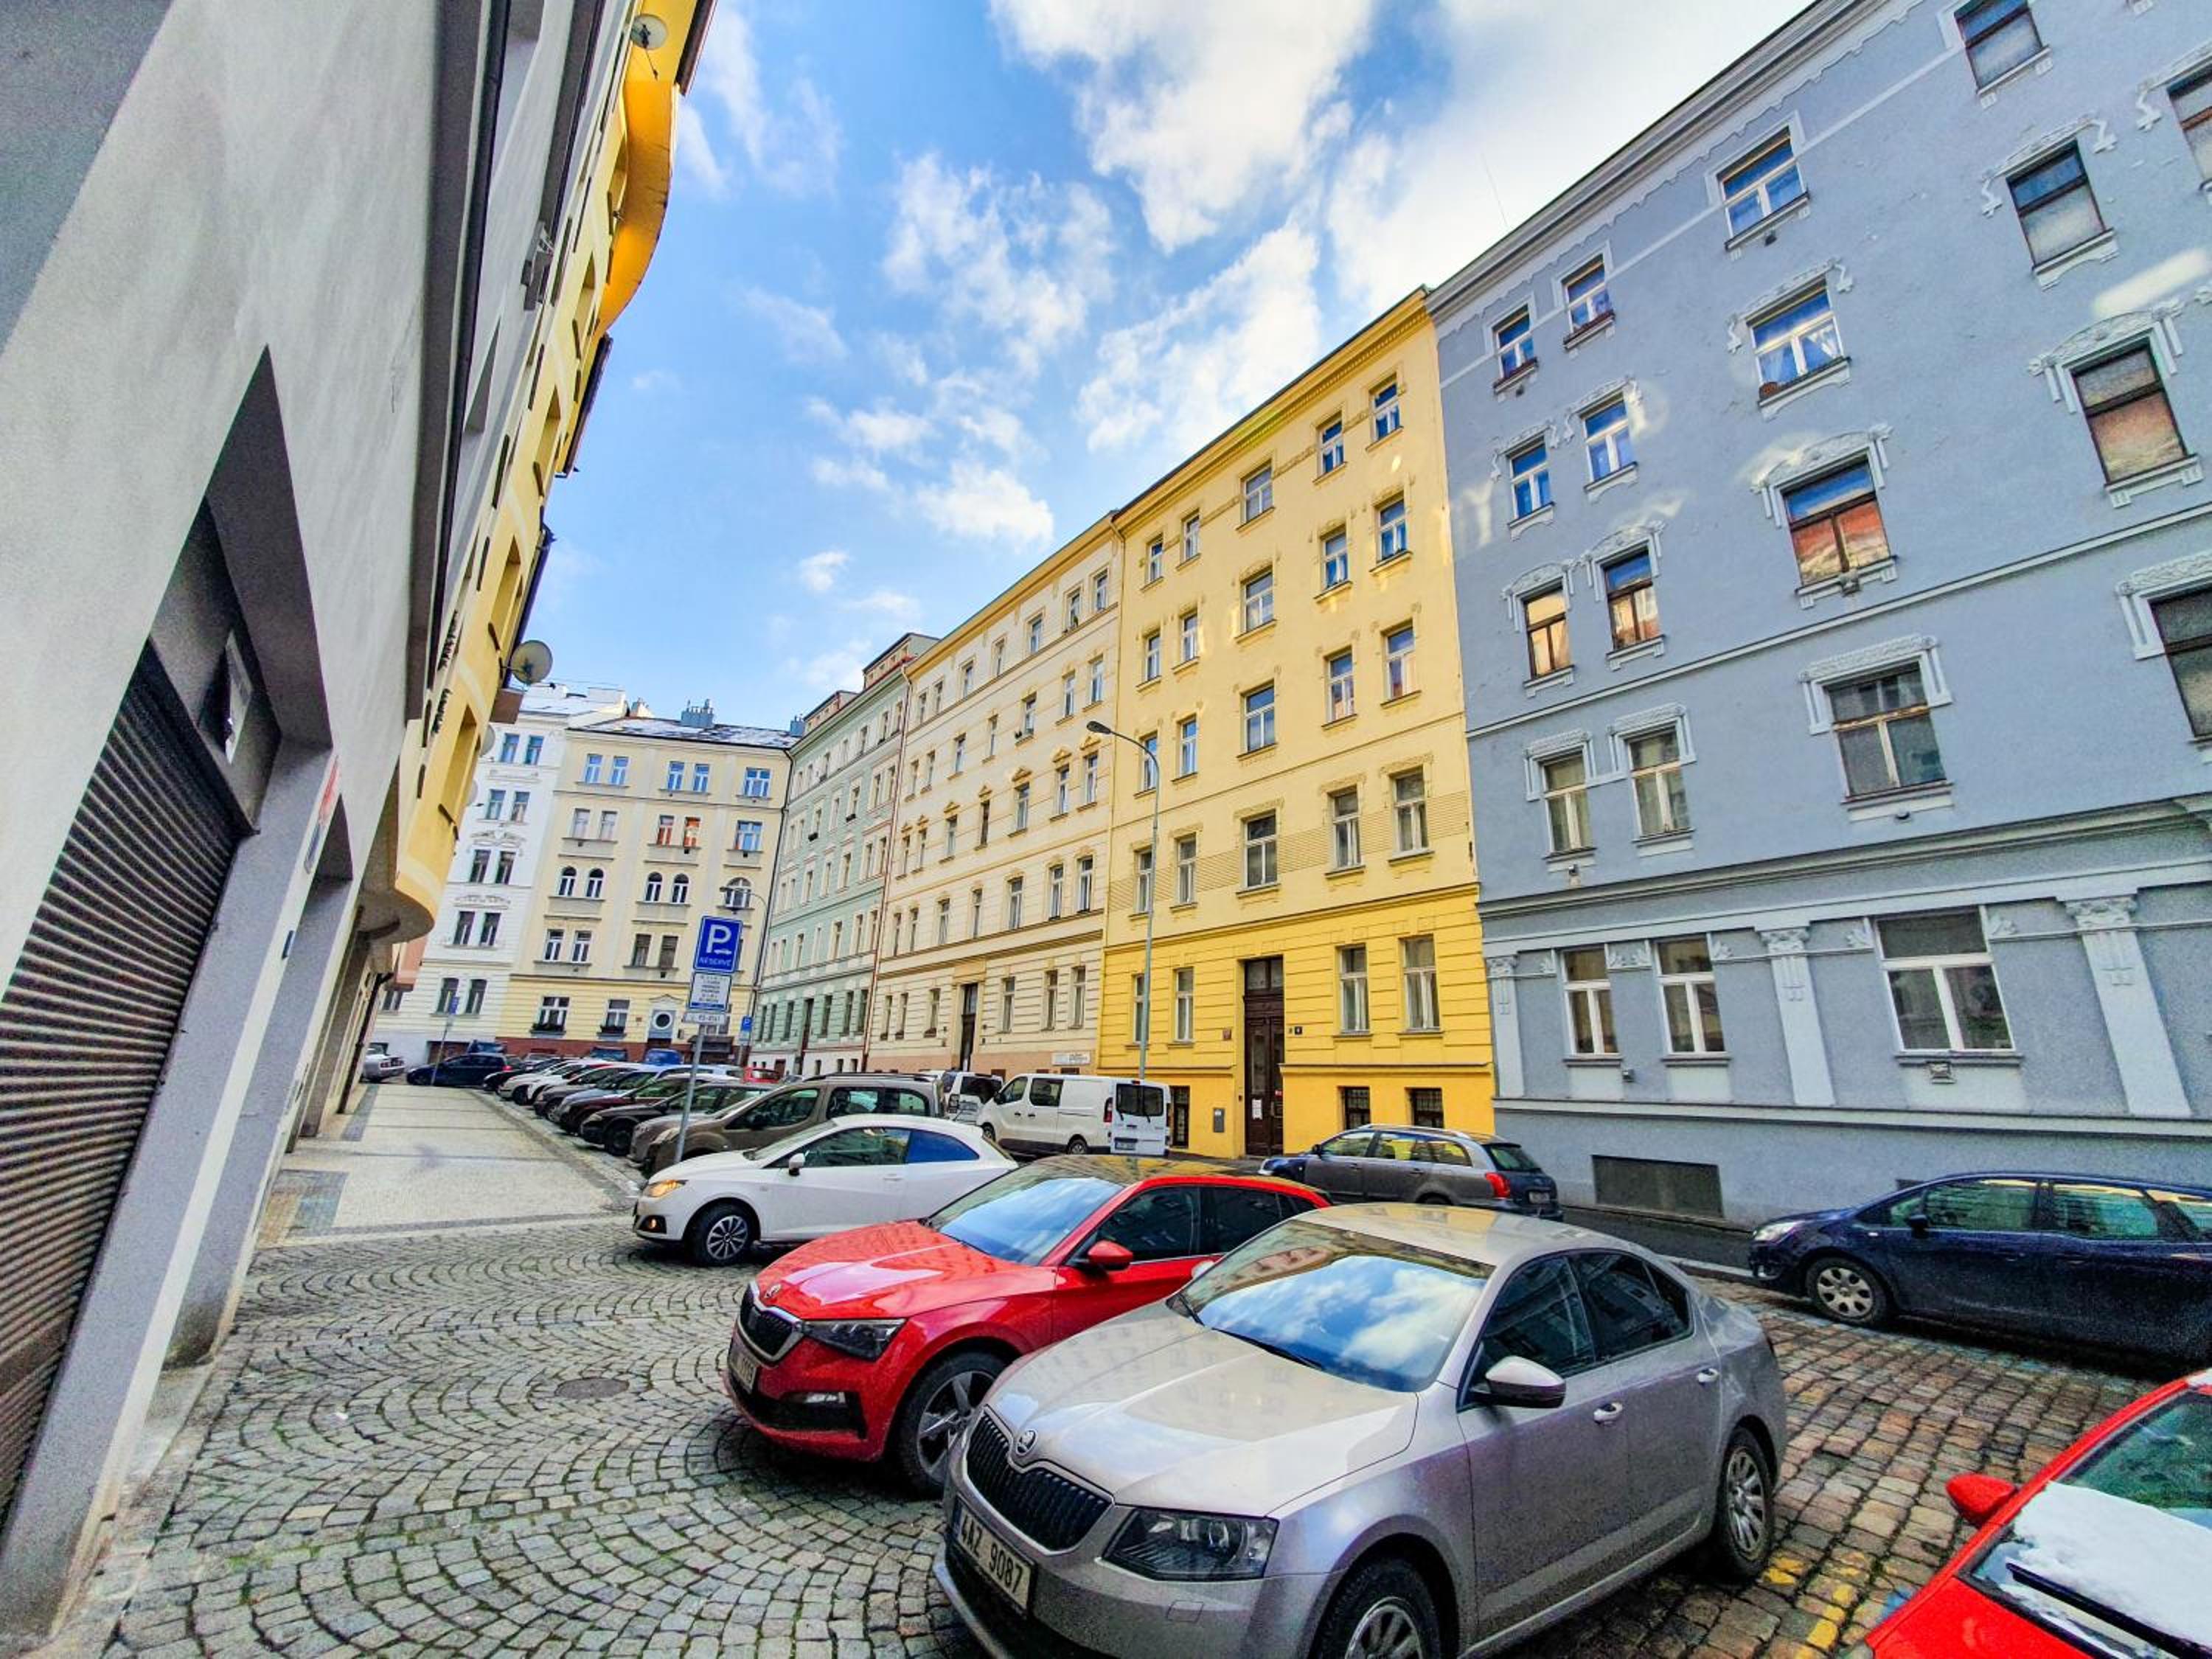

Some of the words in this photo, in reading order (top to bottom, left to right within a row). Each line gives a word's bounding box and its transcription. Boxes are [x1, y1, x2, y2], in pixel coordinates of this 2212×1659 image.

[706, 924, 731, 953] P
[961, 1514, 983, 1558] 4AZ
[989, 1543, 1023, 1594] 9087
